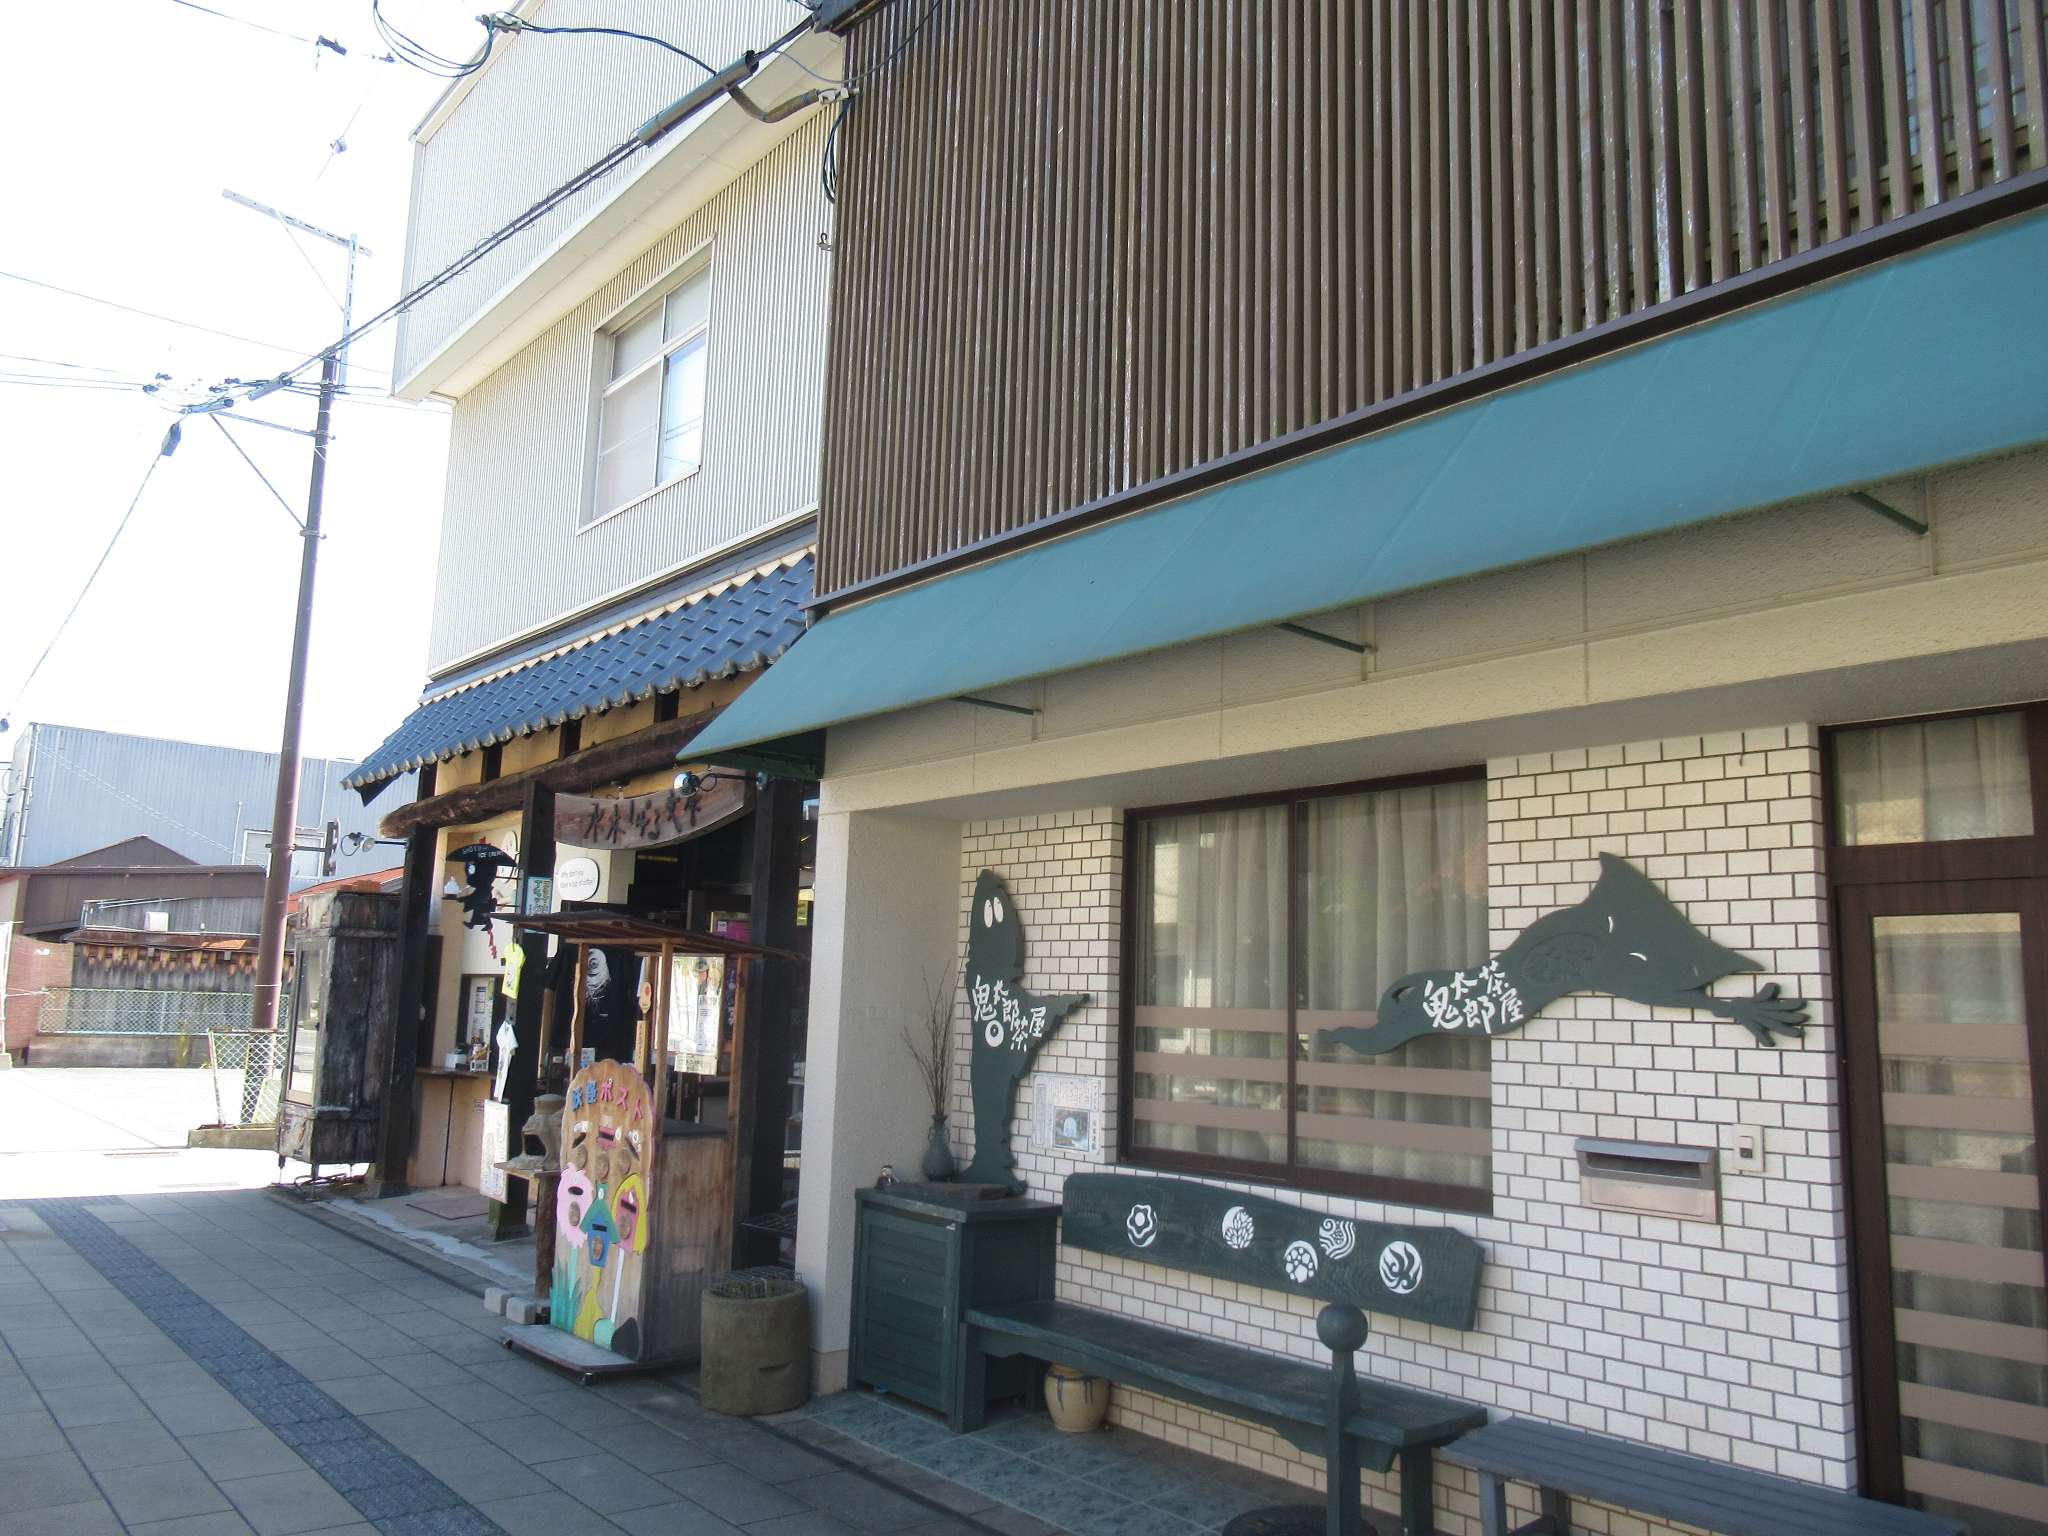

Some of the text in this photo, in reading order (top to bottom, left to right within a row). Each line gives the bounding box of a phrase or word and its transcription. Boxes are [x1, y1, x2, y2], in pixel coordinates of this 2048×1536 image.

[972, 974, 1047, 1052] 鬼太郎茶屋
[1422, 960, 1524, 1034] 鬼太郎茶屋
